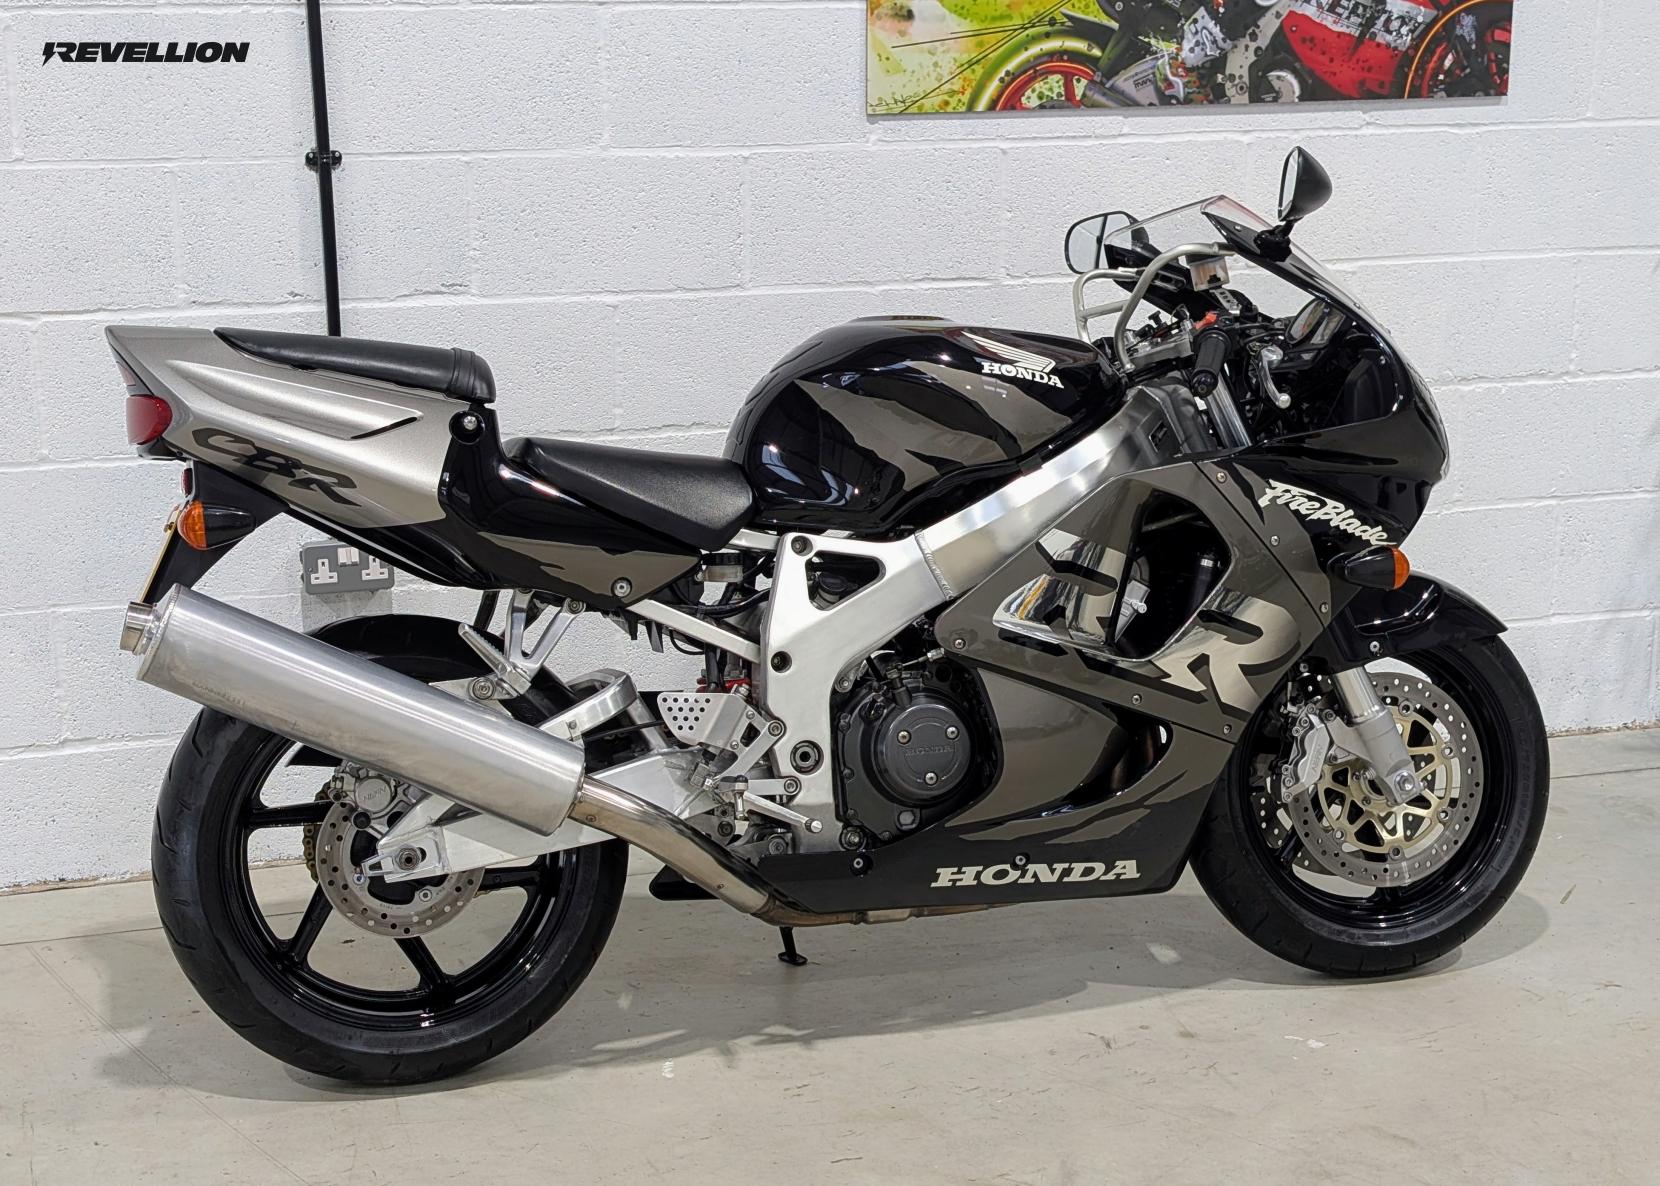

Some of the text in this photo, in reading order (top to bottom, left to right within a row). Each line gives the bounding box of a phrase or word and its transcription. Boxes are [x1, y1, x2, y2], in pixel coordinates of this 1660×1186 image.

[981, 361, 1064, 389] HONDA
[191, 427, 363, 507] CBR
[1257, 481, 1398, 546] FireBlade
[930, 859, 1142, 888] HONDA
